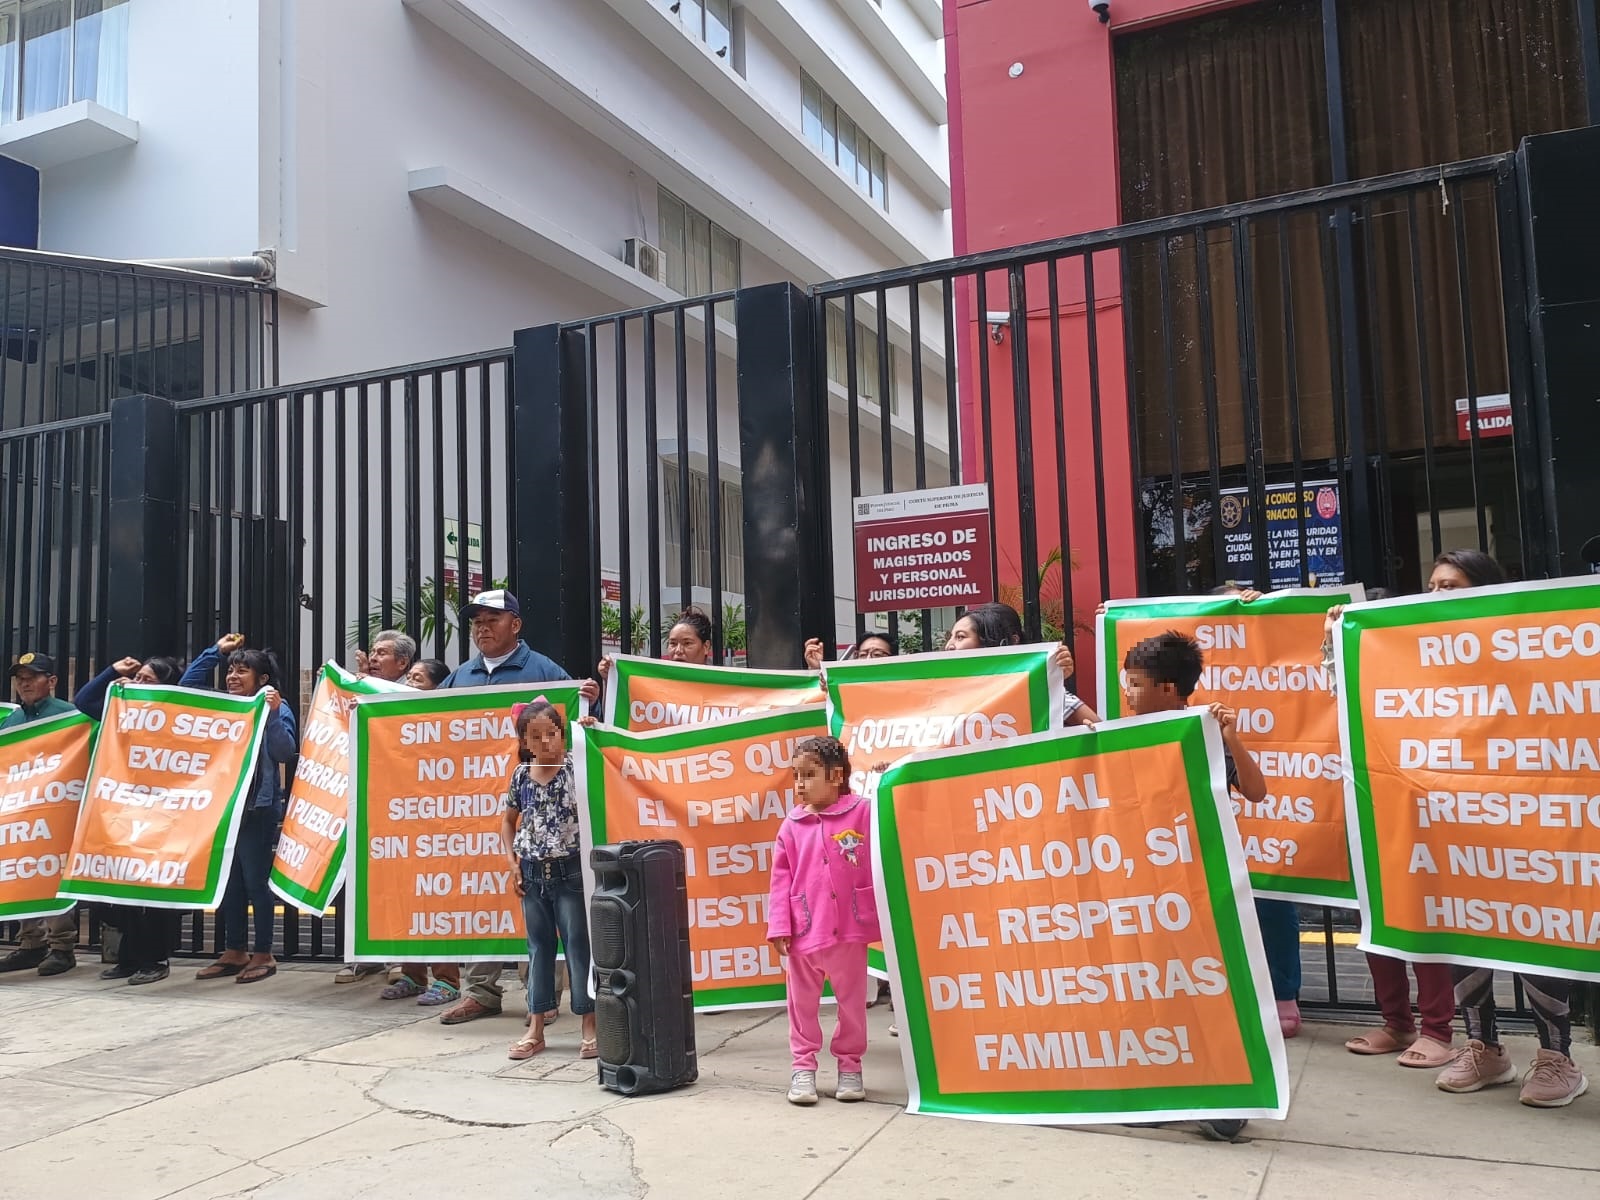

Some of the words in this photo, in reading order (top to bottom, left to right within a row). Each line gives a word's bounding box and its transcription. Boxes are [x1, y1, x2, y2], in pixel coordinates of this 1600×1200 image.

[1270, 491, 1315, 505] CONGSO
[867, 531, 947, 552] INGRESO
[952, 528, 977, 545] DE
[1272, 530, 1283, 539] LA
[1283, 526, 1338, 538] INSURIDAD
[1280, 536, 1338, 549] ALTEATIVAS
[873, 550, 972, 570] MAGISTRADOS
[1228, 554, 1239, 563] DE
[1280, 550, 1292, 559] EN
[1292, 548, 1317, 558] PIRA
[1318, 548, 1324, 556] Y
[1325, 547, 1337, 556] EN
[868, 582, 981, 602] JURISDICCIONAL
[880, 574, 888, 585] Y
[893, 567, 967, 584] PERSONAL
[1195, 623, 1246, 650] SIN
[1418, 632, 1481, 667] RIO
[1491, 622, 1600, 662] SECO
[1374, 683, 1517, 718] EXISTIA
[171, 713, 246, 743] SECO
[305, 719, 335, 746] NO
[399, 719, 442, 746] SIN
[448, 712, 519, 742] SEÑA
[847, 712, 1018, 756] ¡QUEREMOS
[6, 752, 63, 784] MÁS
[128, 745, 211, 776] EXIGE
[418, 757, 455, 783] NO
[463, 753, 511, 779] HAY
[621, 748, 735, 785] ANTES
[744, 735, 817, 776] QU
[1399, 738, 1474, 770] DEL
[1487, 737, 1600, 771] PENA
[0, 779, 85, 812] ELLOS
[94, 777, 213, 811] RESPETO
[388, 795, 508, 821] SEGURIDA
[973, 783, 1043, 833] ¡NO
[1056, 773, 1110, 814] AL
[291, 797, 346, 841] PUEBLO
[637, 796, 677, 828] EL
[128, 819, 151, 843] Y
[370, 835, 408, 860] SIN
[415, 832, 508, 858] SEGURI
[707, 840, 777, 877] EST
[914, 834, 1135, 892] DESALOJO,
[1145, 813, 1193, 867] SÍ
[1408, 843, 1438, 875] A
[71, 853, 190, 886] DIGNIDAD!
[415, 872, 452, 897] NO
[460, 871, 511, 896] HAY
[408, 910, 516, 936] JUSTICIA
[938, 913, 990, 950] AL
[998, 892, 1192, 946] RESPETO
[690, 945, 788, 982] UEBL
[928, 973, 986, 1012] DE
[995, 956, 1228, 1009] NUESTRAS
[974, 1025, 1195, 1072] FAMILIAS!
